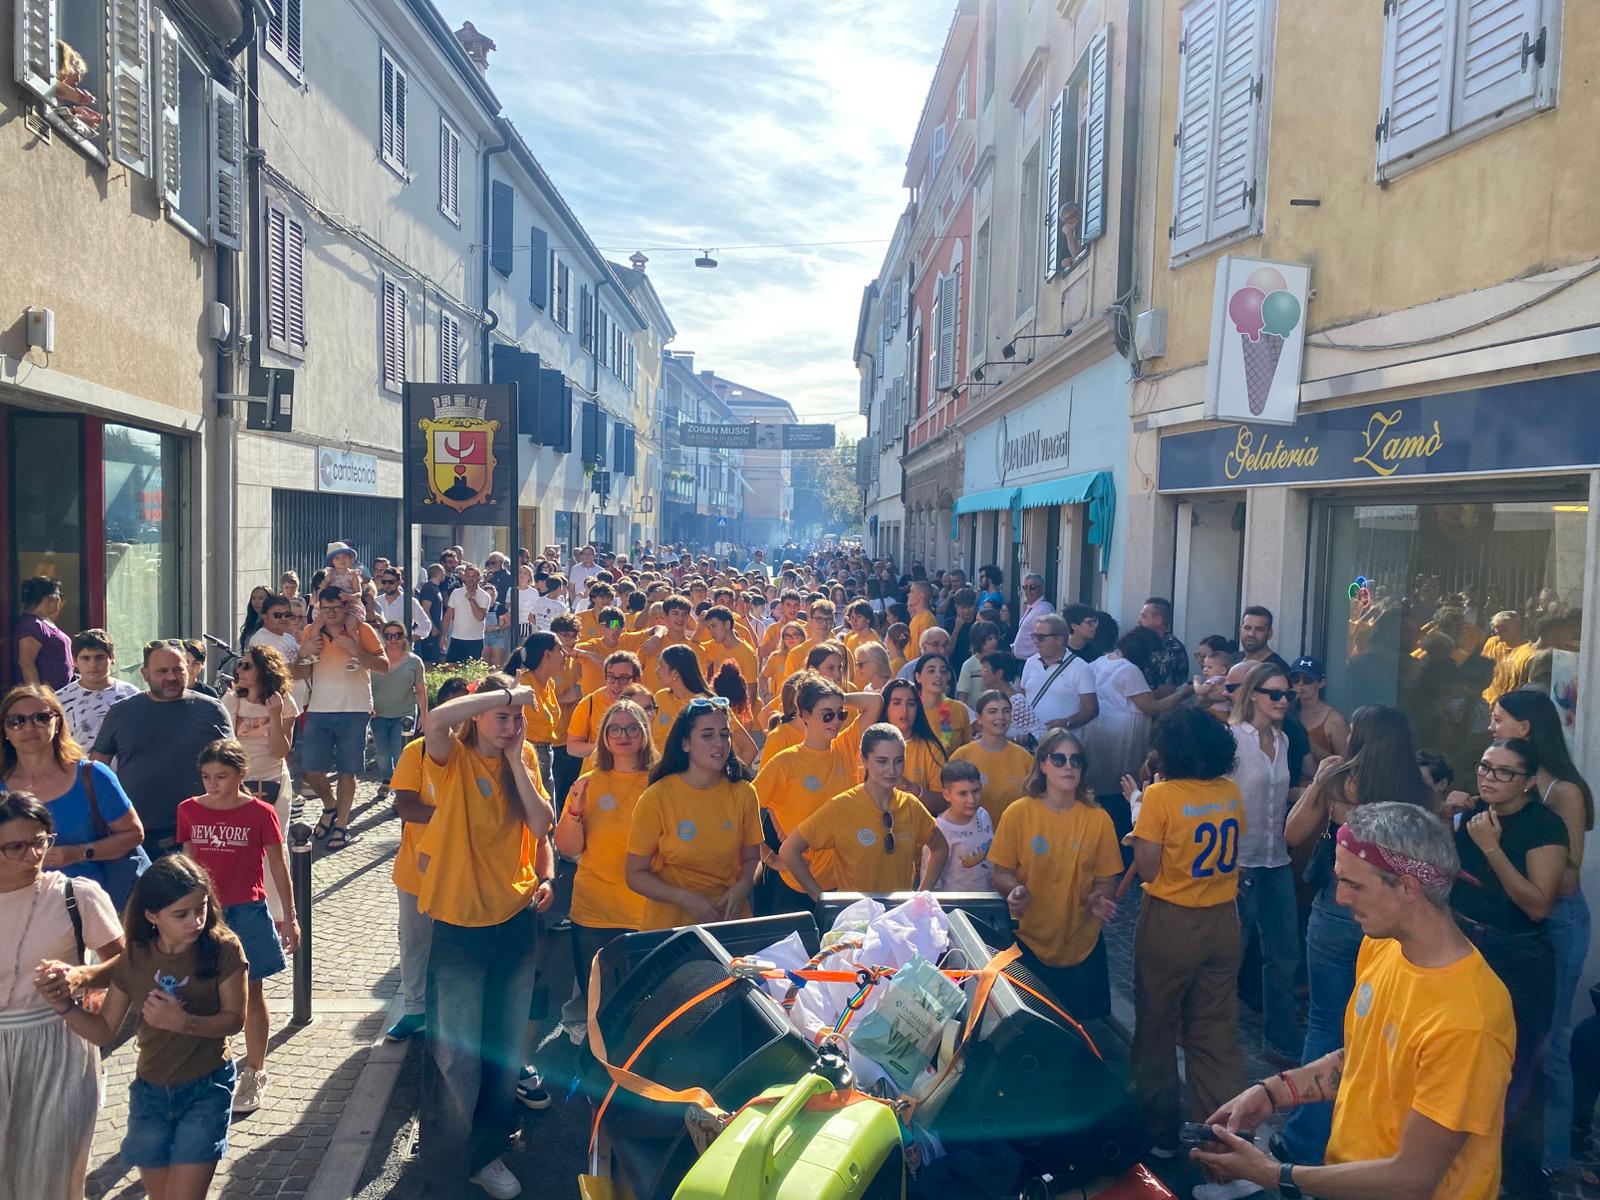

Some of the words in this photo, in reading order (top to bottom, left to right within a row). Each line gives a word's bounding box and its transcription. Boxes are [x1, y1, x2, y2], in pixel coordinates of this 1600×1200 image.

[687, 425, 718, 434] ZORAN
[720, 426, 750, 435] MUSIC
[996, 415, 1040, 487] QUARIN
[1041, 430, 1068, 461] VIAGGI
[1225, 425, 1318, 479] Gelateria
[1353, 409, 1443, 476] Zamò
[191, 825, 216, 839] NEW
[219, 826, 250, 841] YORK
[1191, 817, 1239, 878] 20
